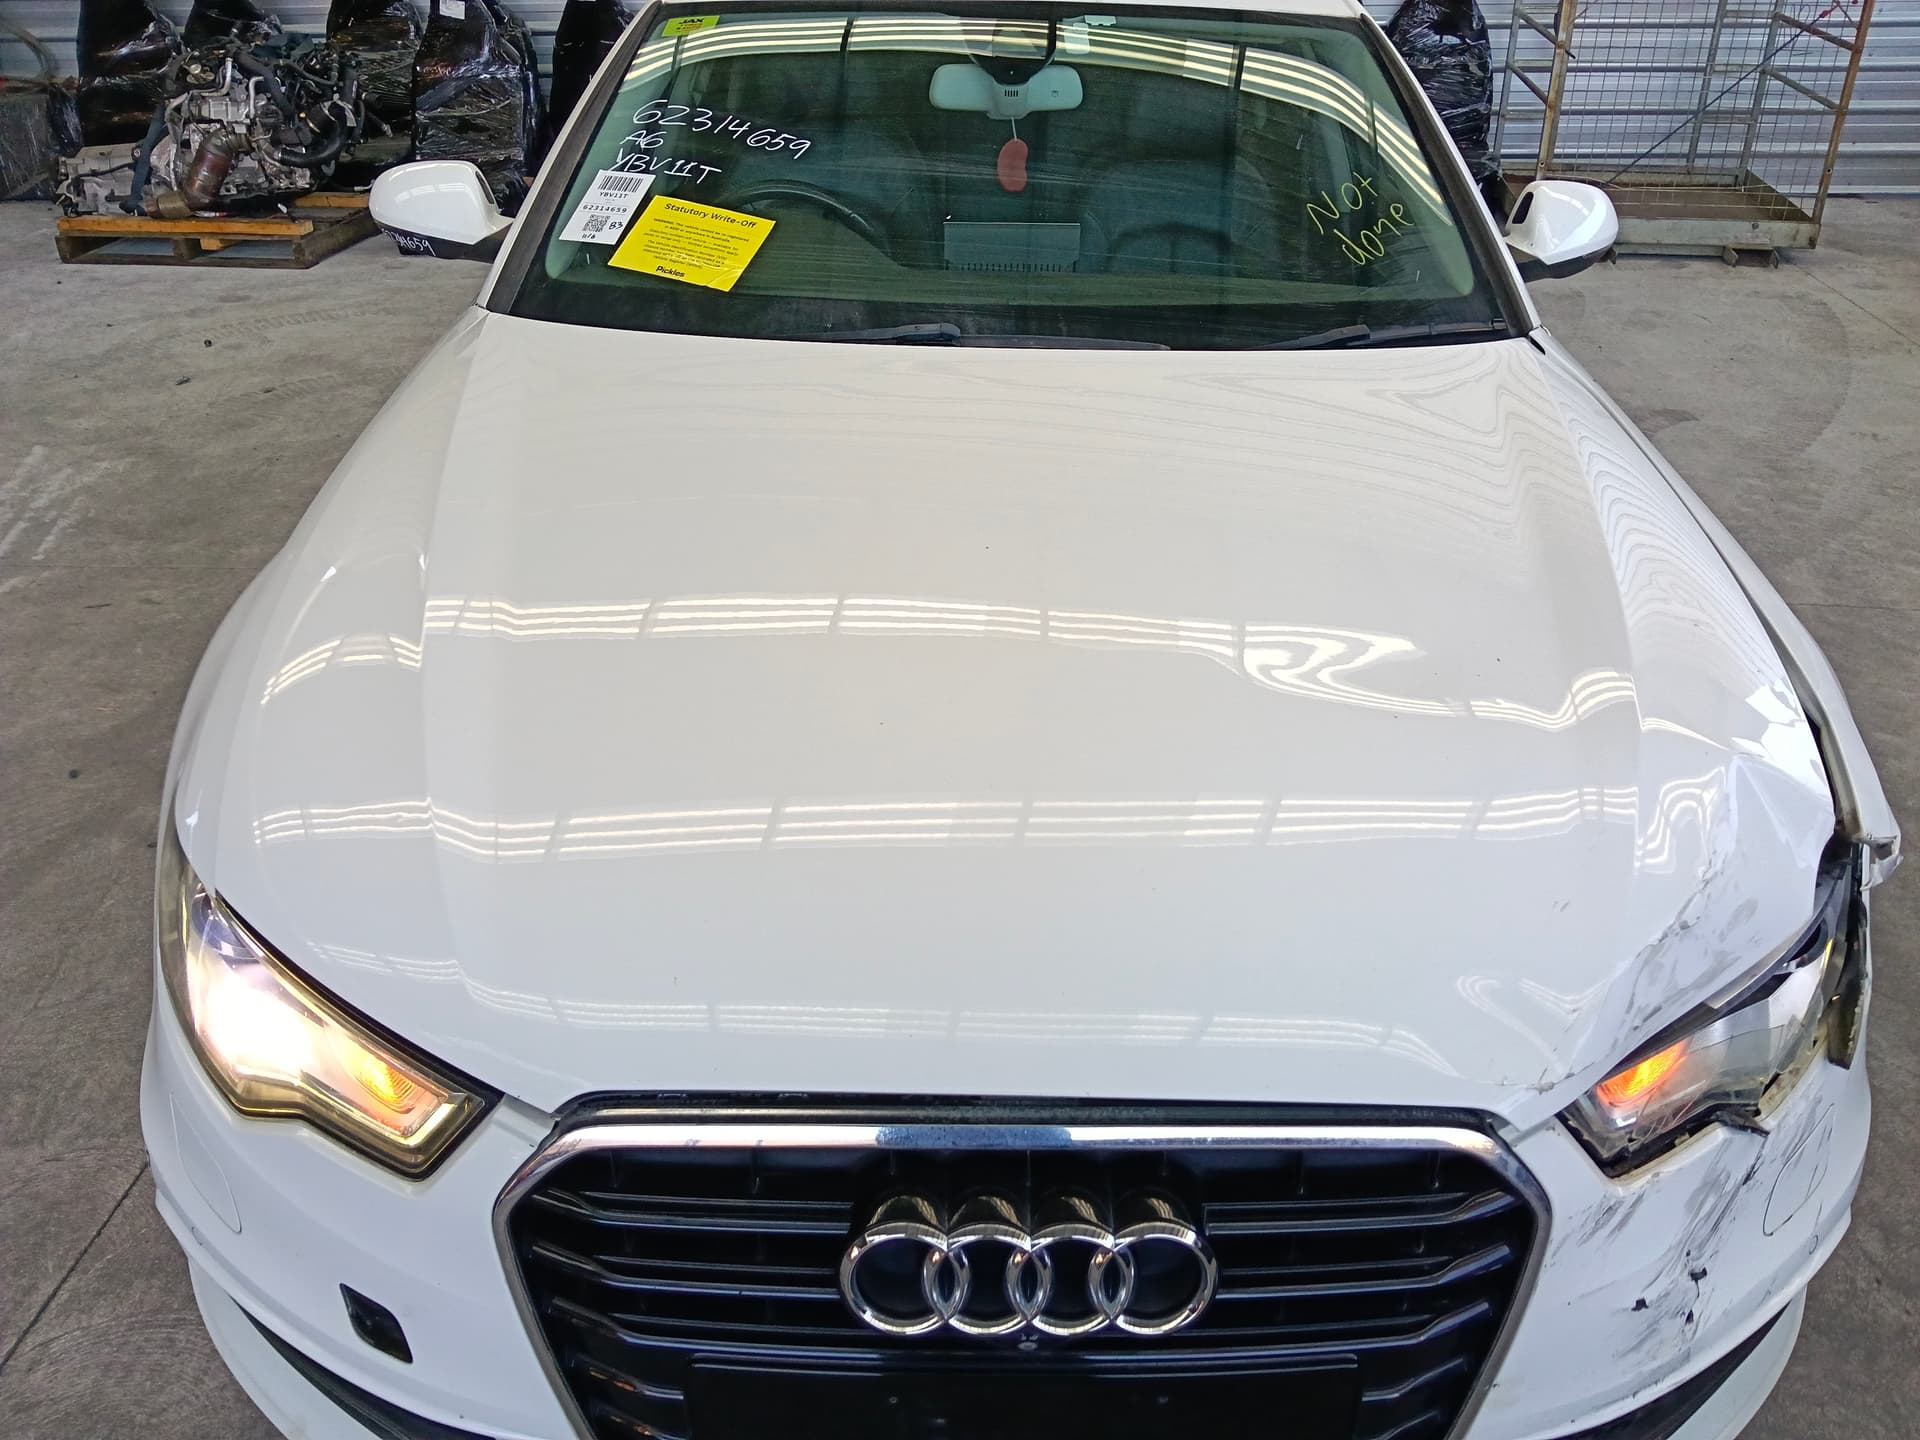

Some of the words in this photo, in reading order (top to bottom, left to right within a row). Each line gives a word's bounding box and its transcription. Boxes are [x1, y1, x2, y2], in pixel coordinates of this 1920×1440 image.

[632, 99, 811, 160] 62314659
[619, 129, 667, 151] A6
[599, 191, 629, 199] YBV11T
[583, 204, 627, 214] 62314659
[664, 203, 709, 219] Statutory
[711, 212, 756, 228] Write-Off
[656, 265, 686, 278] Pickles
